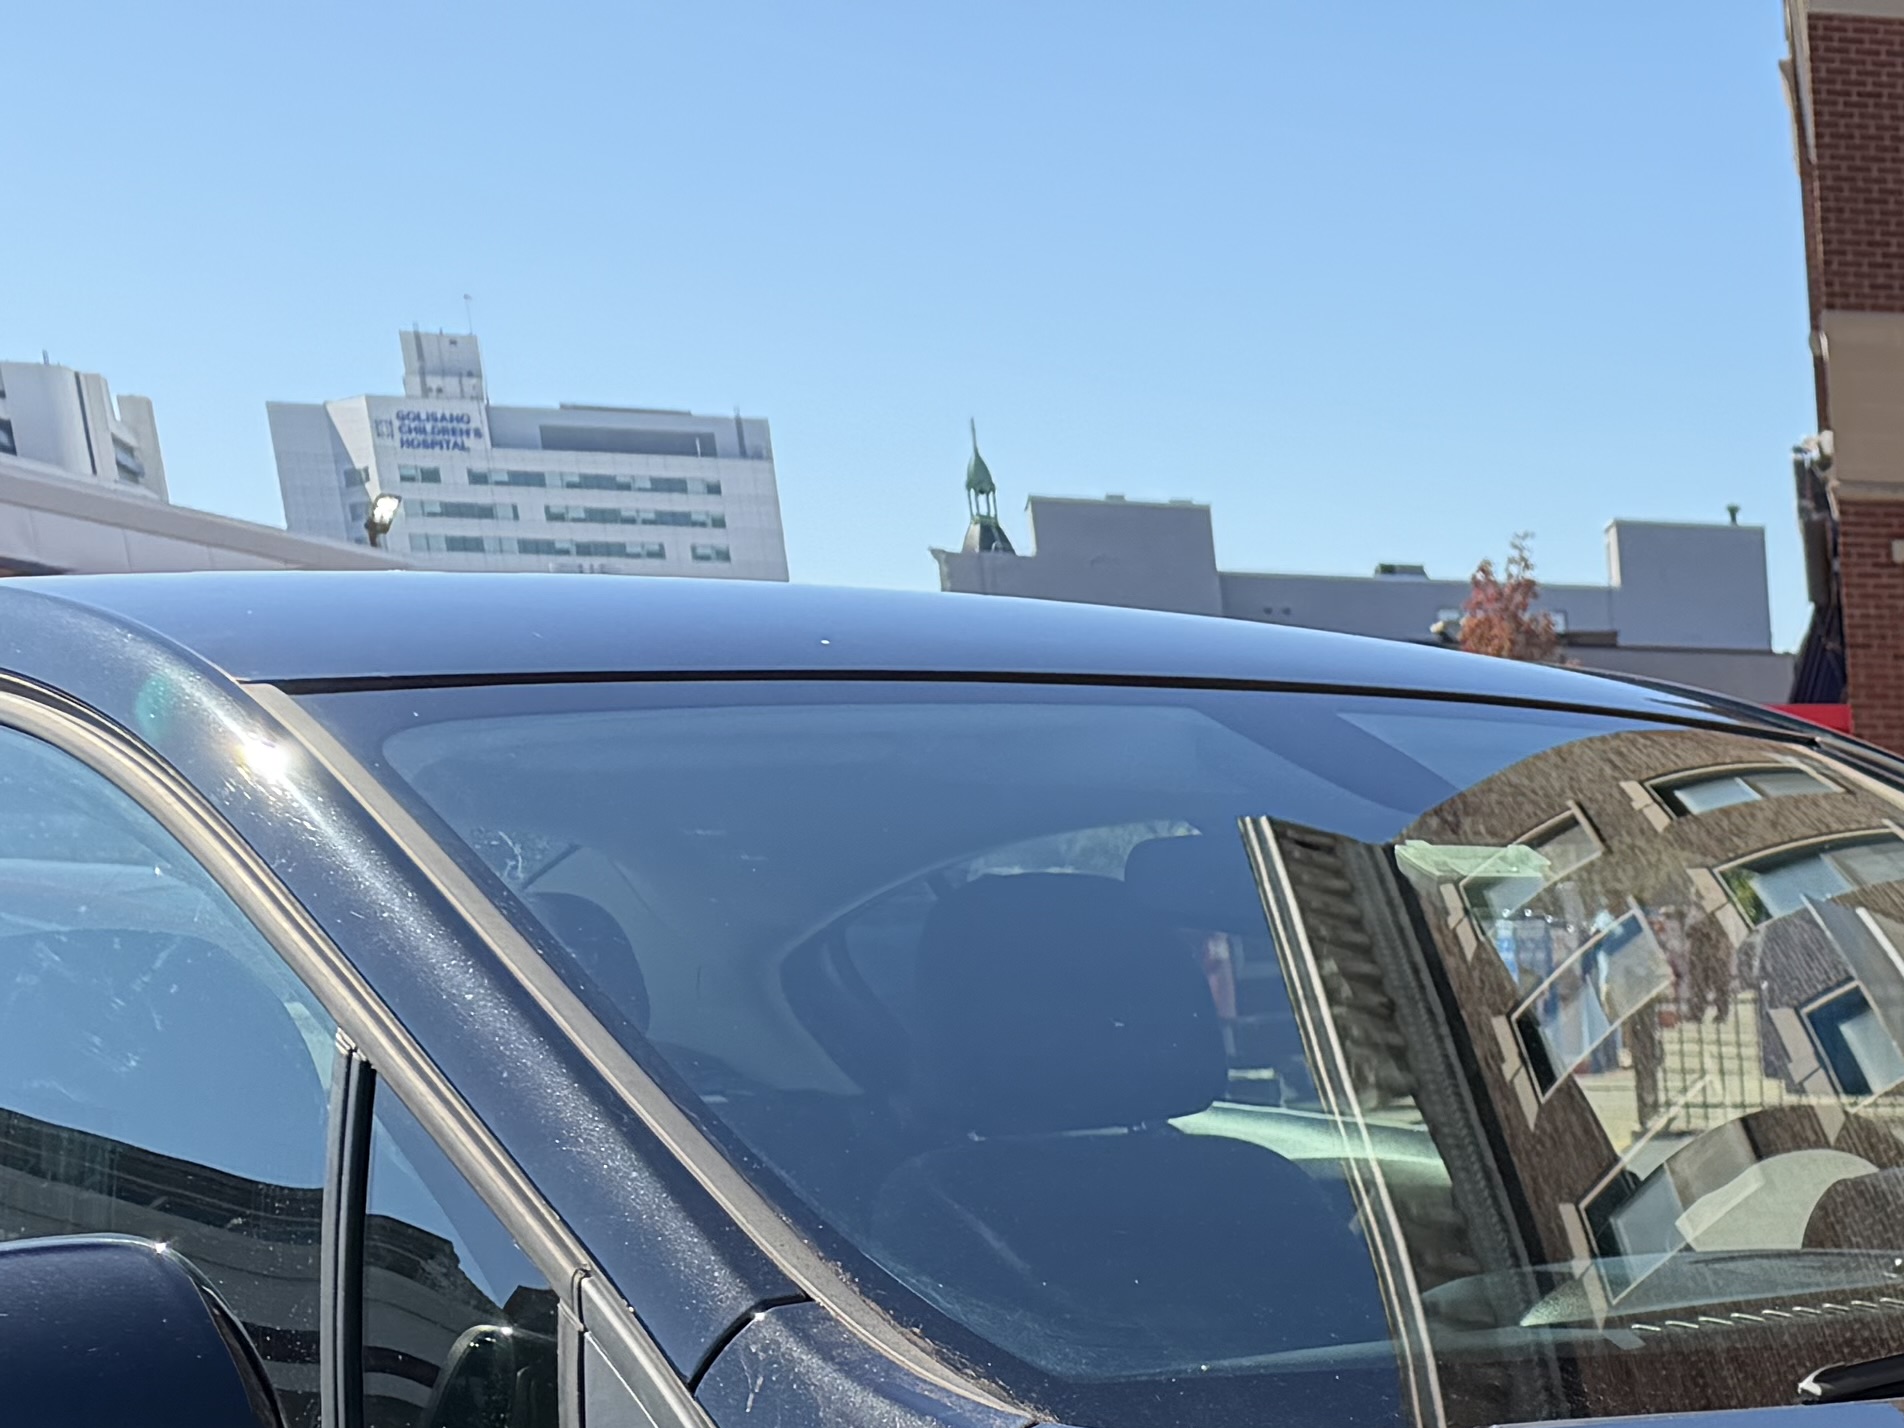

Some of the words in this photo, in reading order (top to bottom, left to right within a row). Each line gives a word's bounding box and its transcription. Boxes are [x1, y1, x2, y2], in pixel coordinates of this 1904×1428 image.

[396, 410, 471, 424] GOLISANO
[398, 422, 483, 439] CHILDREN'S
[400, 437, 471, 452] HOSPITAL
